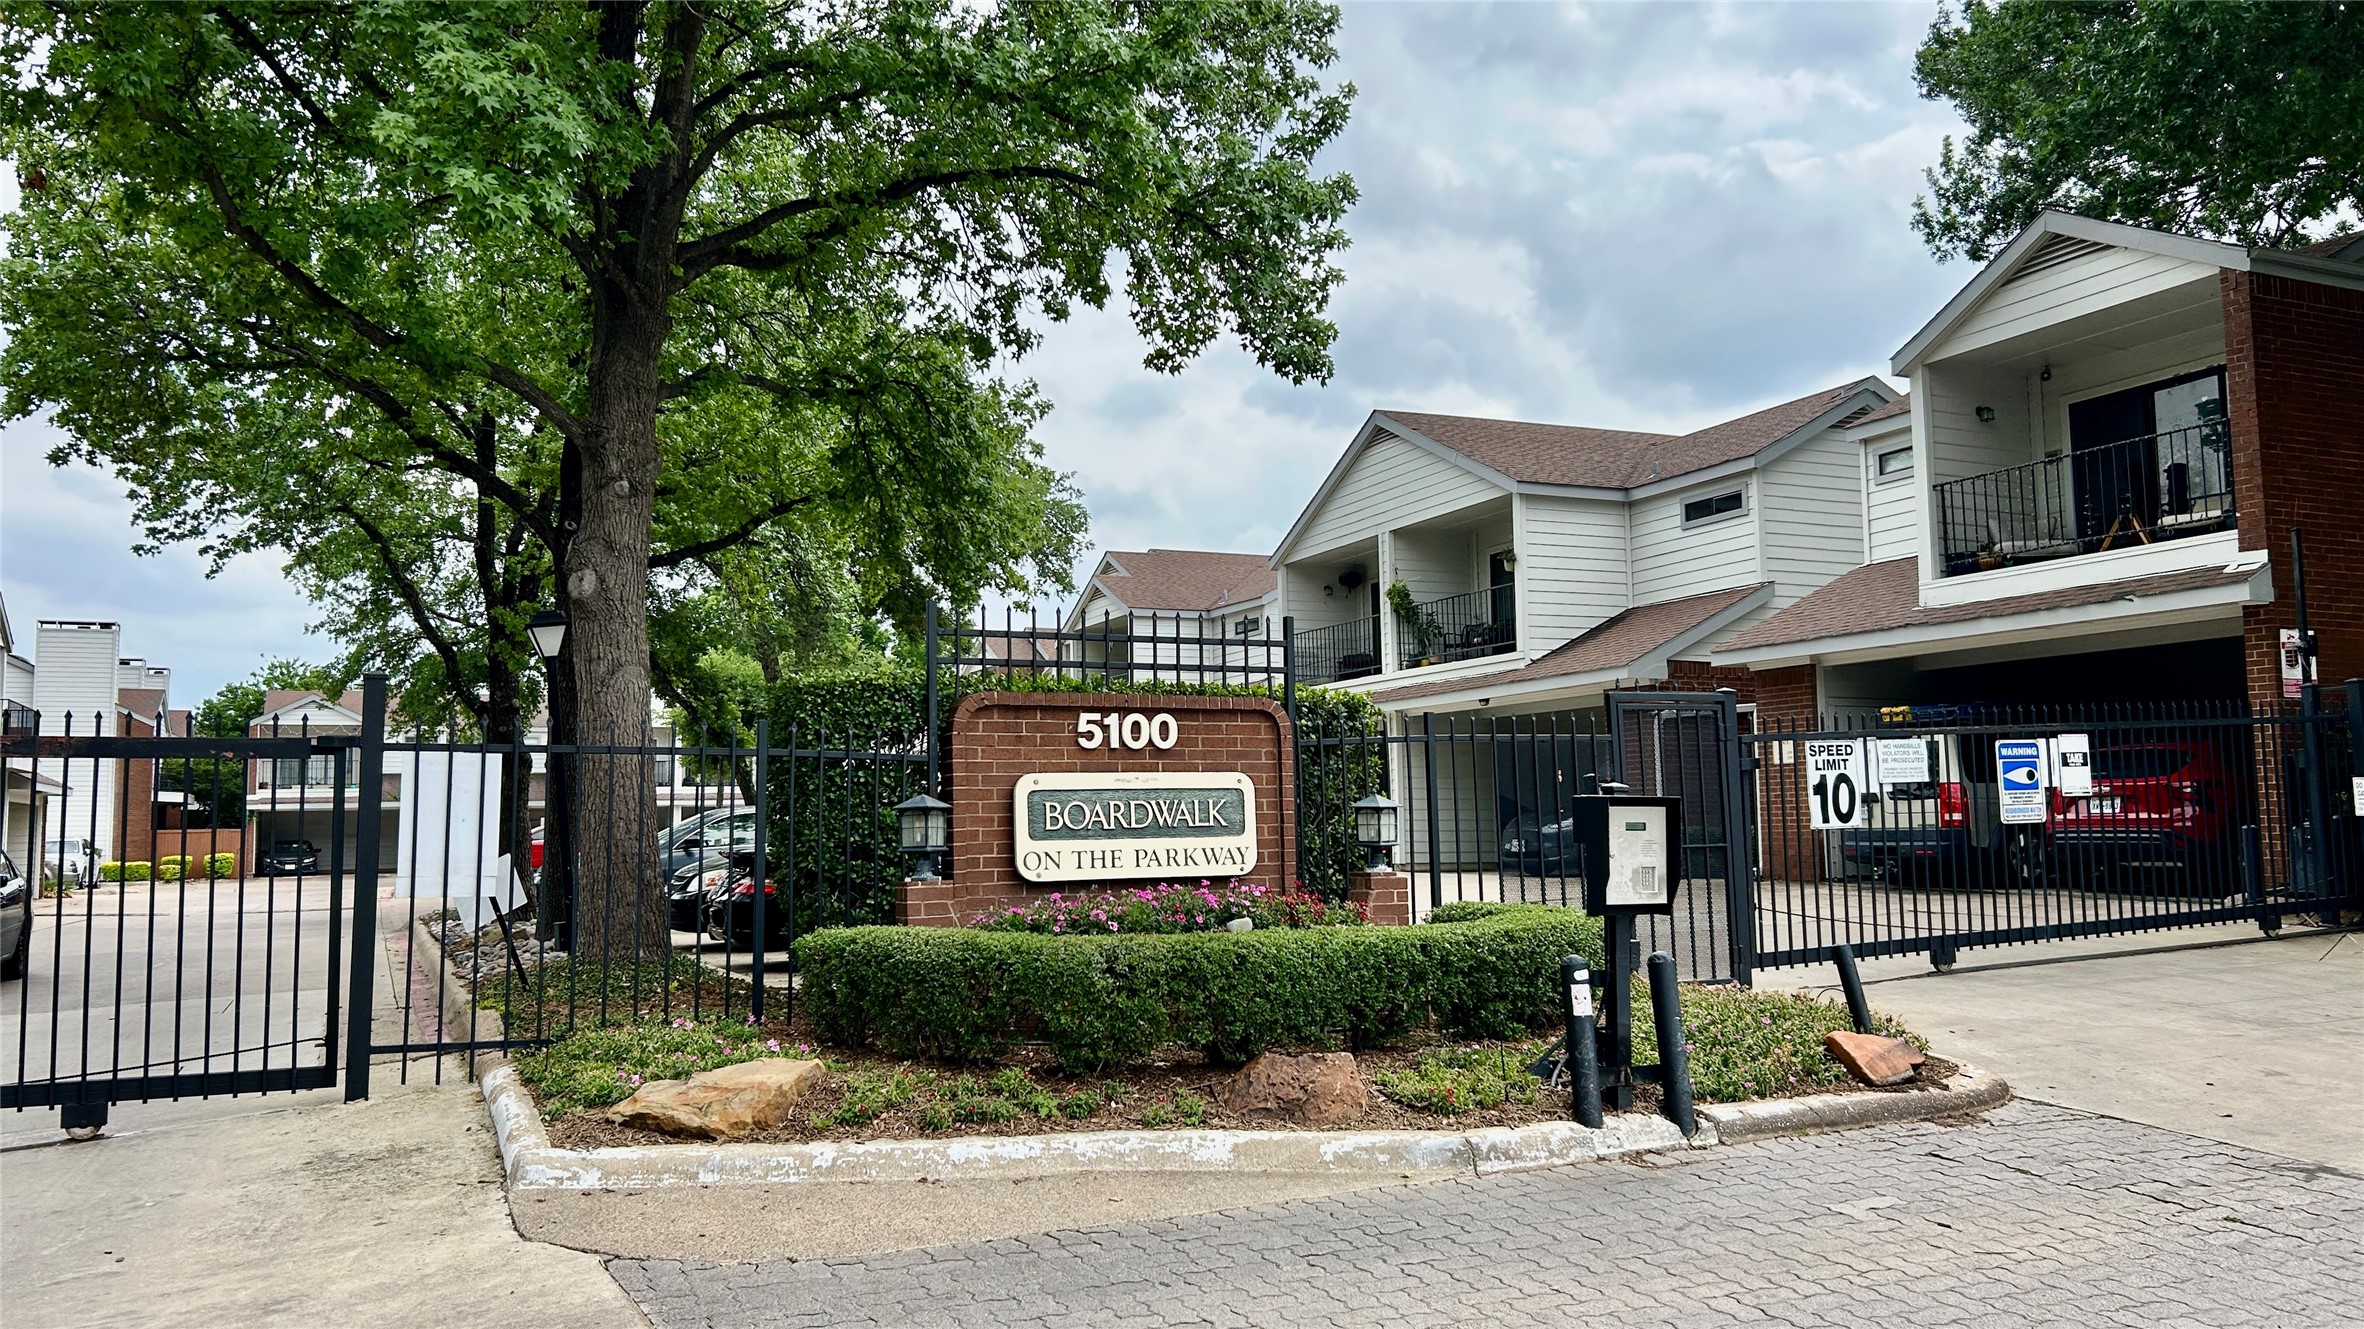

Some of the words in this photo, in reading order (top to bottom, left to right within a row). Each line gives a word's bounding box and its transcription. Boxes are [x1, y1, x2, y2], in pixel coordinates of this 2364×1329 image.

[1077, 712, 1179, 750] 5100
[1808, 744, 1854, 757] SPEED
[2000, 747, 2038, 756] WARNING
[2066, 752, 2084, 763] TAKE
[1814, 758, 1849, 771] LIMIT
[1812, 772, 1856, 824] 10
[1043, 799, 1229, 832] BOARDWALK
[1023, 850, 1062, 872] ON
[1071, 849, 1123, 870] THE
[1134, 846, 1250, 869] PARKWAY
